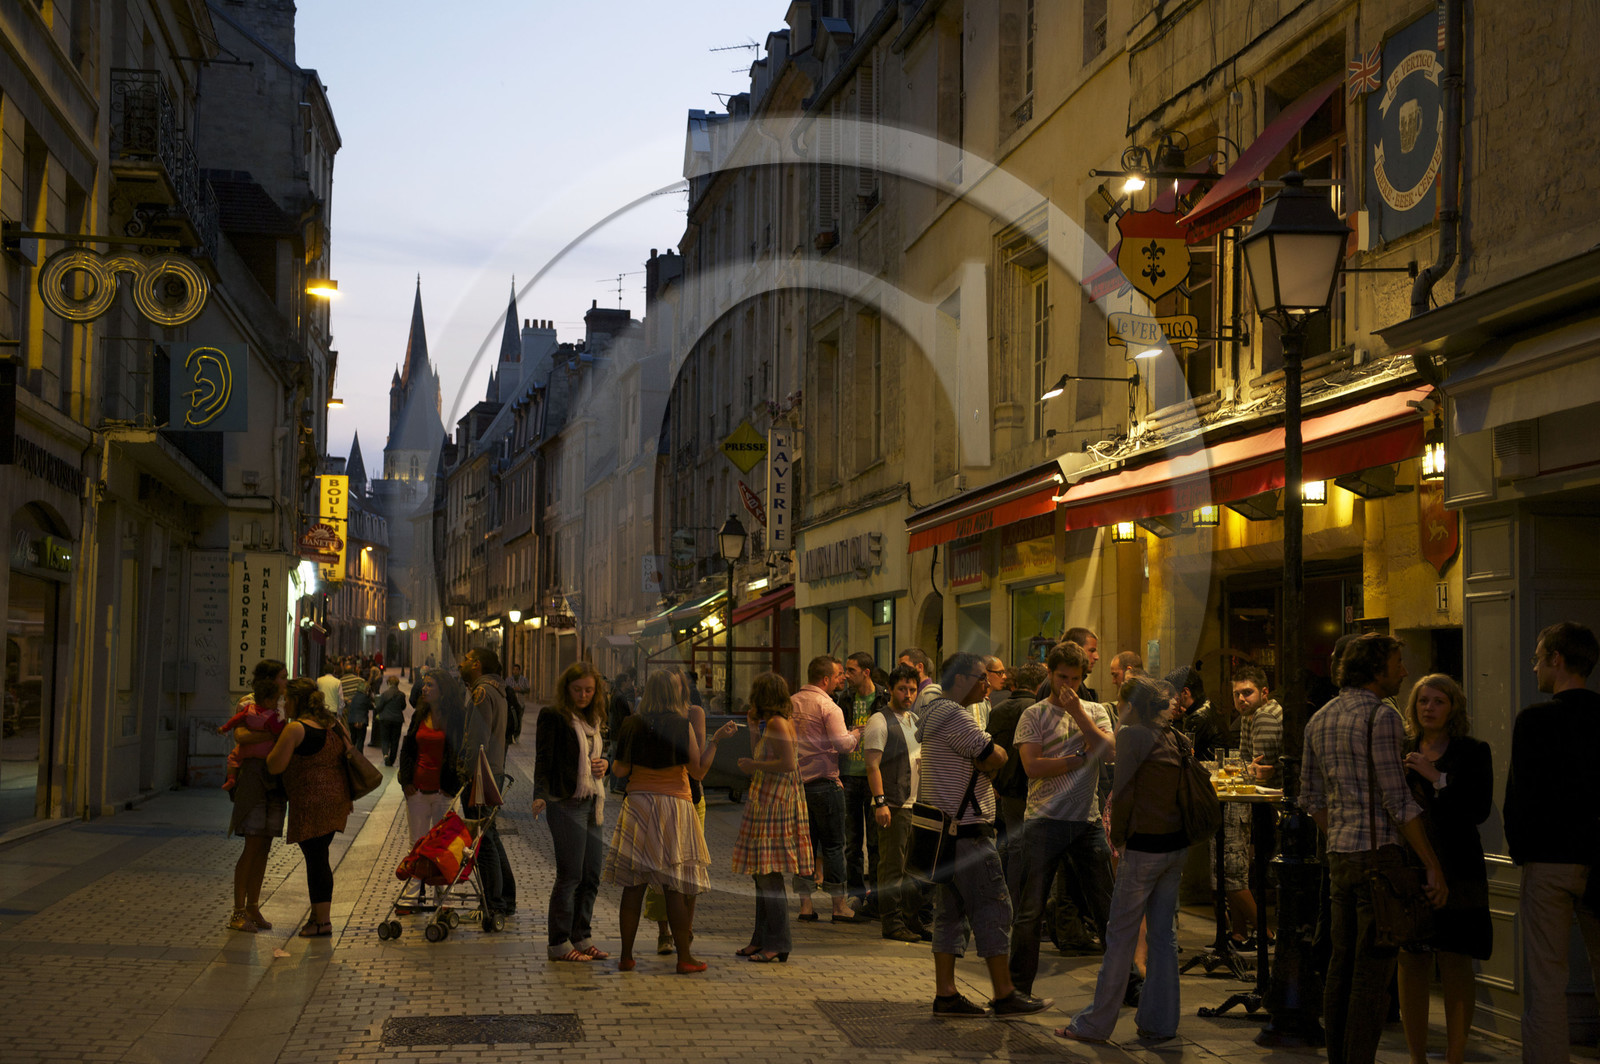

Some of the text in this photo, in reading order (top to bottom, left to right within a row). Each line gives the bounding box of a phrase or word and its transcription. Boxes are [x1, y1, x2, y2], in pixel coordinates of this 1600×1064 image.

[1388, 52, 1434, 93] LE VERTIGO
[1393, 191, 1416, 209] BEER
[1130, 320, 1194, 341] VERTIGO
[724, 442, 767, 452] PRESSE
[740, 485, 766, 522] TABAC
[773, 436, 789, 541] LAVERIE
[644, 558, 653, 591] NOMAD
[259, 567, 271, 659] MALHERBE
[1437, 584, 1448, 609] 14
[239, 560, 251, 687] LABORATOIRE
